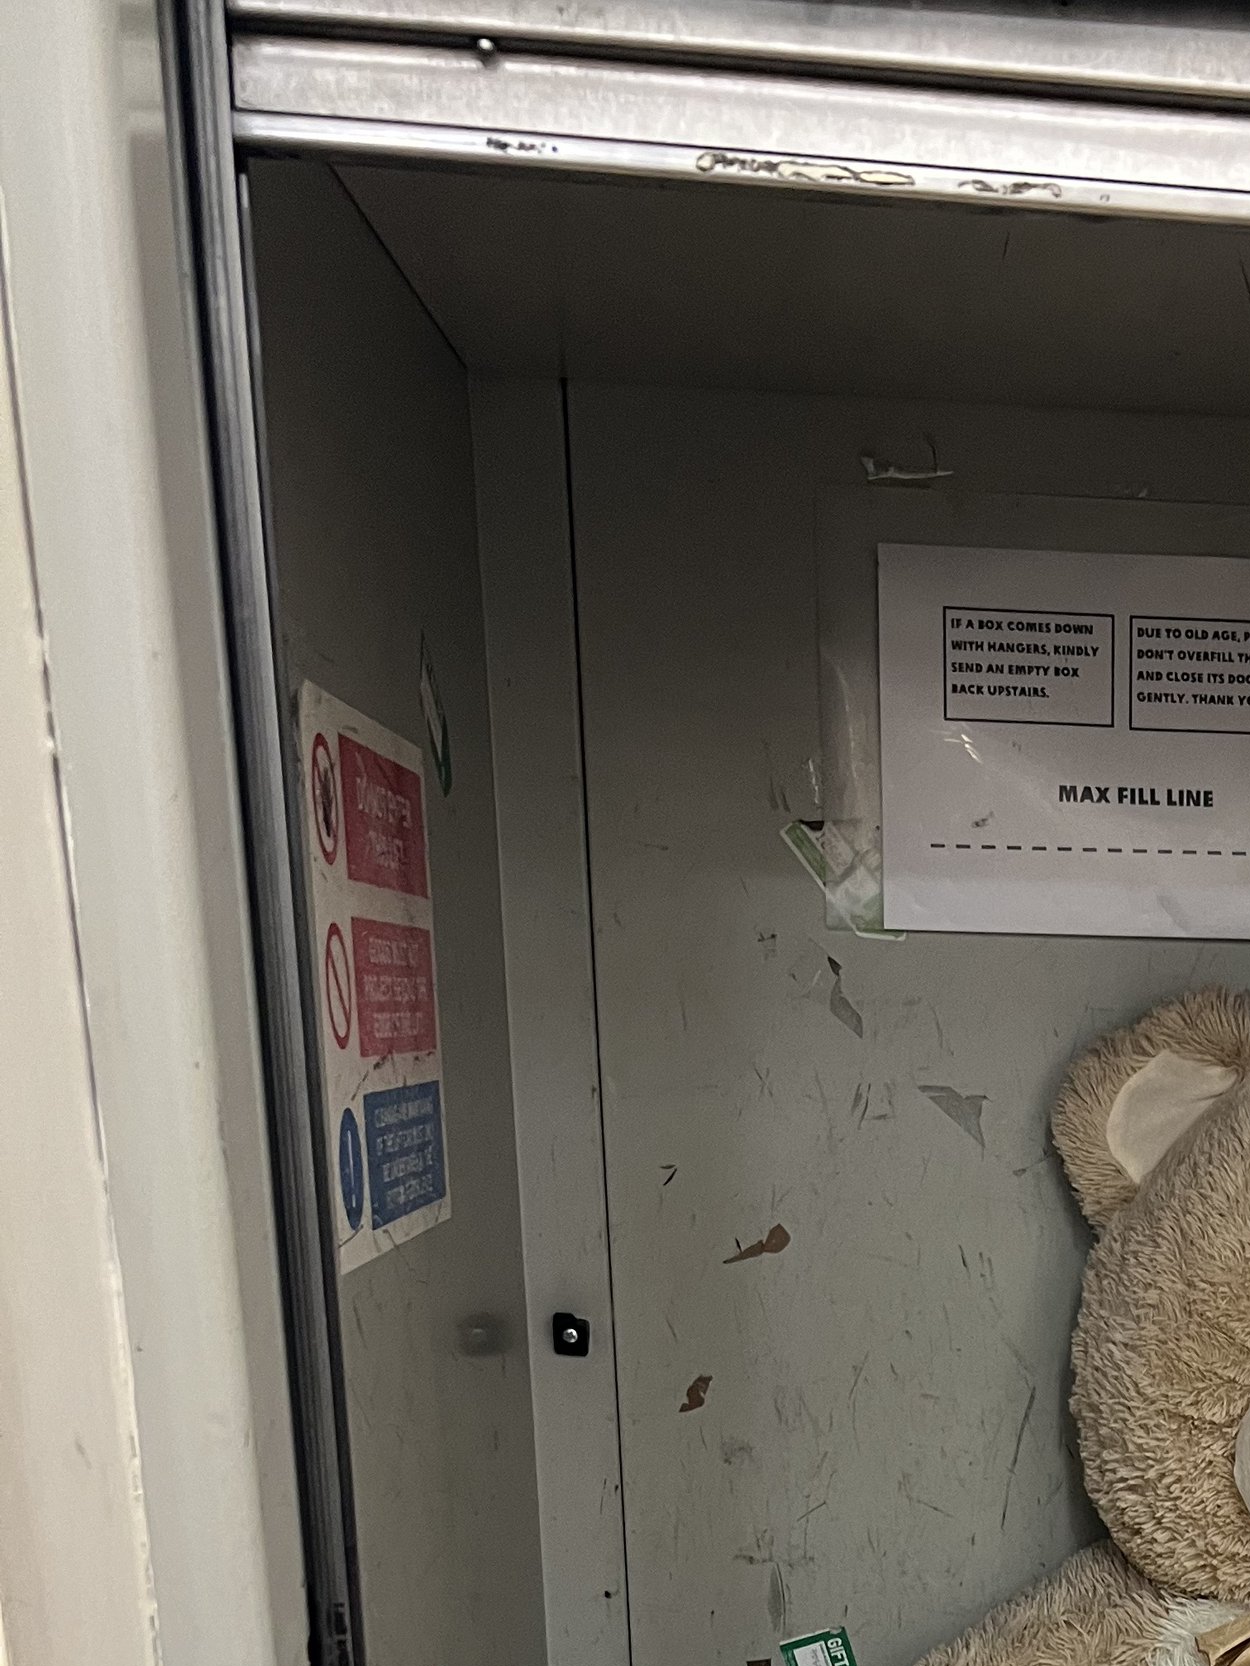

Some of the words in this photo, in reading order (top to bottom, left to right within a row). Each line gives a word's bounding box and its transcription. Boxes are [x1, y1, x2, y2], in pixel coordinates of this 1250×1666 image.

[951, 618, 962, 629] IF
[965, 619, 974, 629] A
[978, 620, 1003, 631] BOX
[1007, 621, 1051, 633] COMES
[1055, 623, 1093, 635] DOWN
[1137, 627, 1161, 639] DUE
[1165, 628, 1182, 639] TO
[1185, 629, 1209, 640] OLD
[1211, 630, 1241, 643] AGE,
[951, 640, 984, 652] WITH
[988, 642, 1050, 656] HANGERS,
[1053, 645, 1099, 657] KINDLY
[1137, 649, 1174, 660] DON'T
[1178, 650, 1234, 663] OVERFILL
[951, 662, 983, 673] SEND
[986, 663, 1004, 674] AN
[1008, 664, 1050, 676] EMPTY
[1054, 667, 1080, 678] BOX
[1137, 671, 1163, 682] AND
[1166, 671, 1203, 683] CLOSE
[1207, 673, 1225, 684] ITS
[951, 683, 984, 695] BACK
[988, 685, 1050, 698] UPSTAIRS.
[1136, 691, 1189, 704] GENTLY.
[1192, 693, 1234, 706] THANK
[1058, 785, 1110, 804] MAX
[1117, 786, 1161, 806] FILL
[1166, 788, 1214, 808] LINE
[827, 1637, 850, 1666] GIFT
